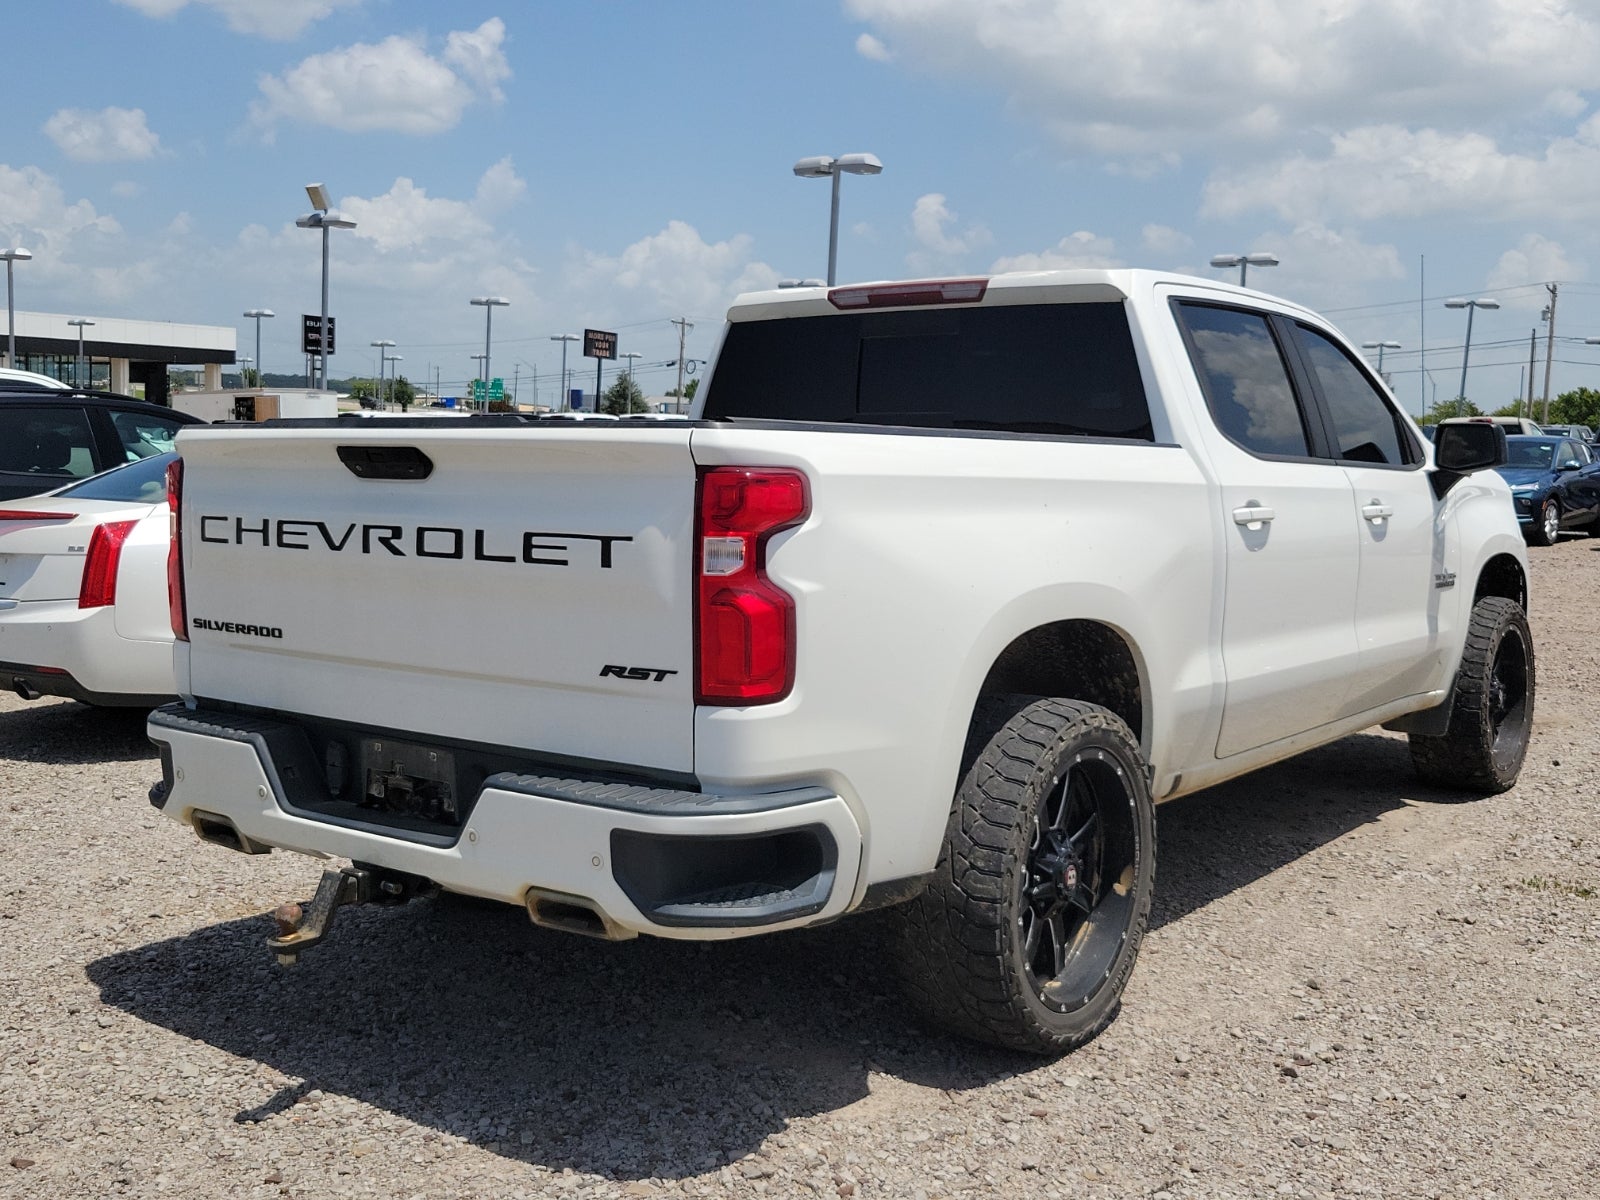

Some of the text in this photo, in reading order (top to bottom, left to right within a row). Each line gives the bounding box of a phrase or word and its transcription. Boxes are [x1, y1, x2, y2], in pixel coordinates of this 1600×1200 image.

[306, 320, 334, 328] BUIK
[201, 515, 633, 568] CHEVROLET
[192, 617, 283, 639] SILVERADO
[599, 664, 679, 682] RST
